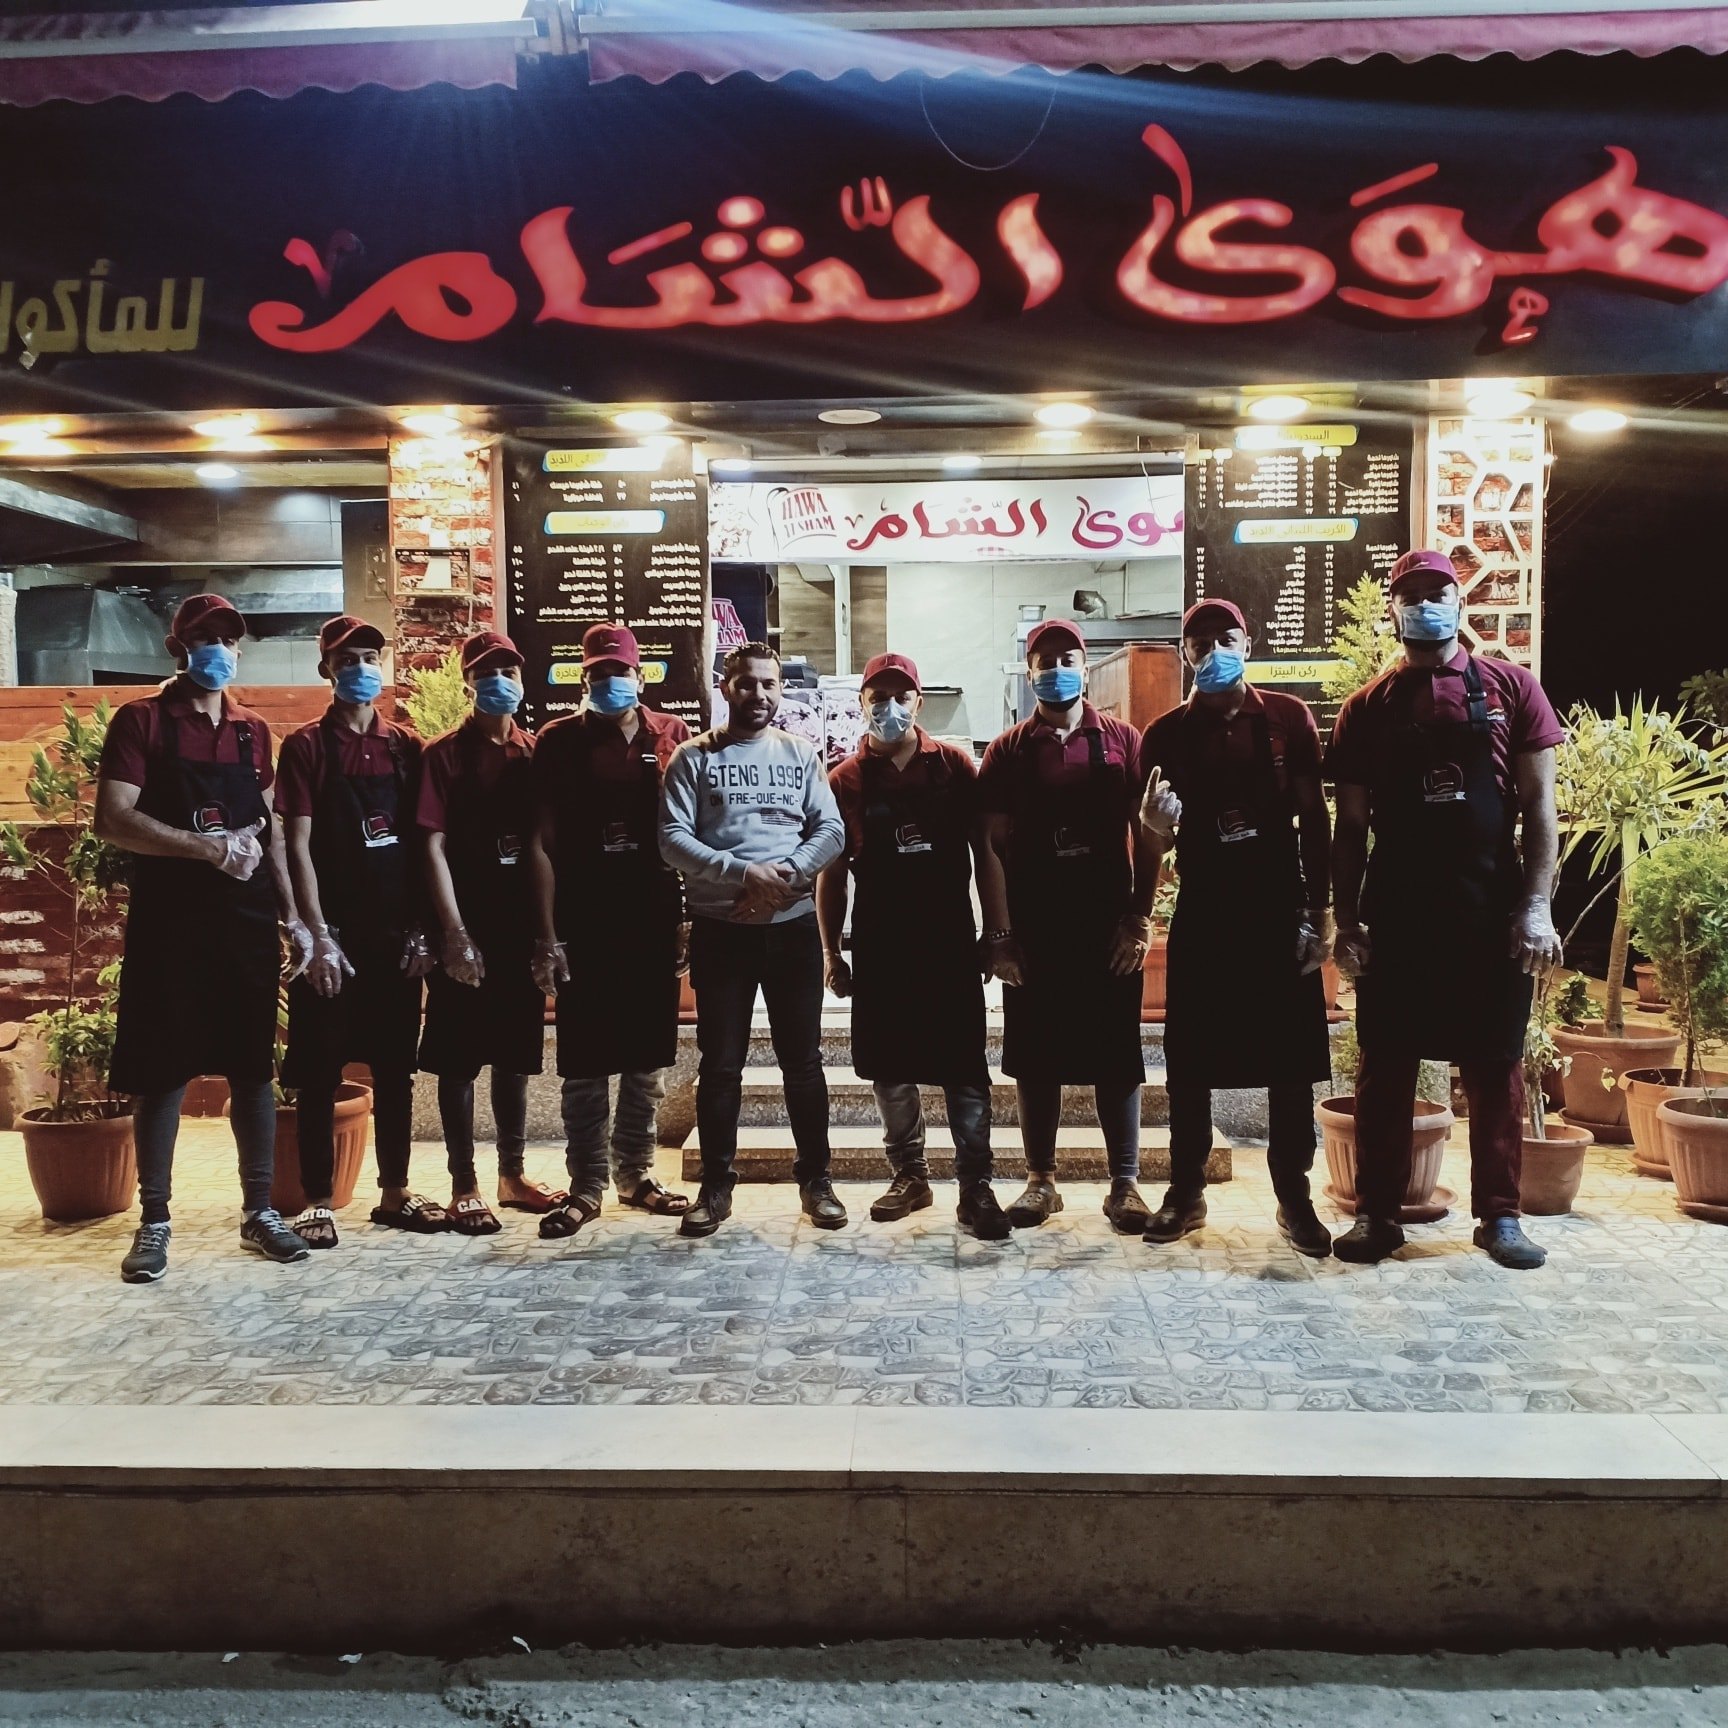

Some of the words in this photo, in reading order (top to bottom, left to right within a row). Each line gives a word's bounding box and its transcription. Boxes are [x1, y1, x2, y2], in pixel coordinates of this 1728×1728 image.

[782, 491, 829, 521] HAWA
[1072, 494, 1184, 550] وى
[768, 764, 804, 790] 1998
